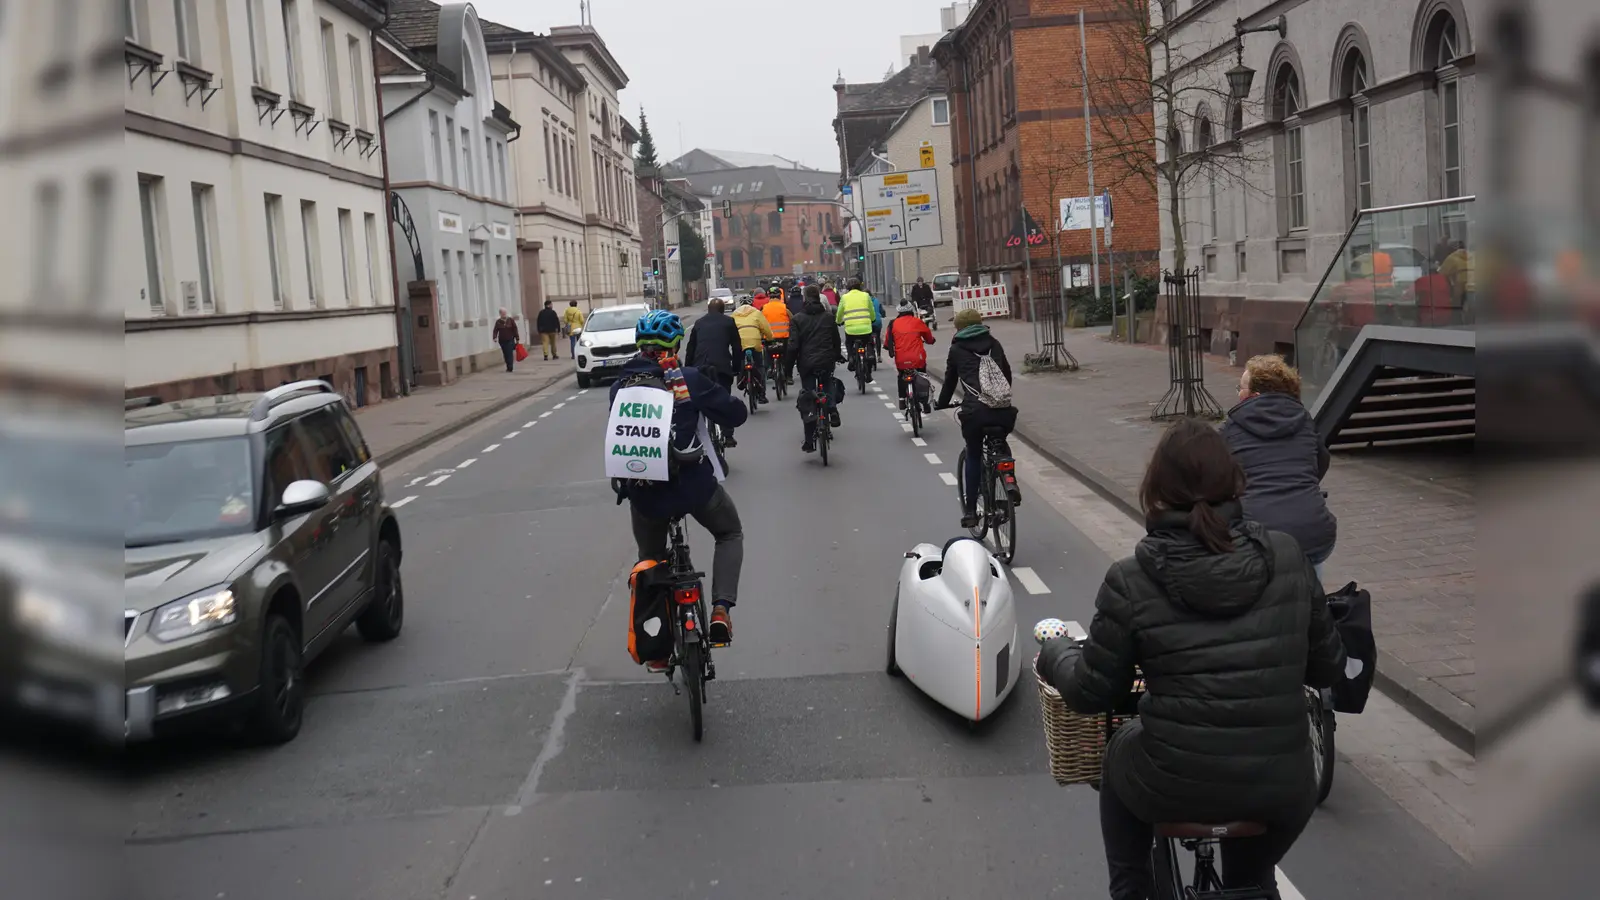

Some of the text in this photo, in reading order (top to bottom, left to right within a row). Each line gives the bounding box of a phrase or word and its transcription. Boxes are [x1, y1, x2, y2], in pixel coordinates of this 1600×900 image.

[618, 402, 663, 420] KEIN
[615, 424, 661, 439] STAUB
[611, 444, 662, 459] ALARM
